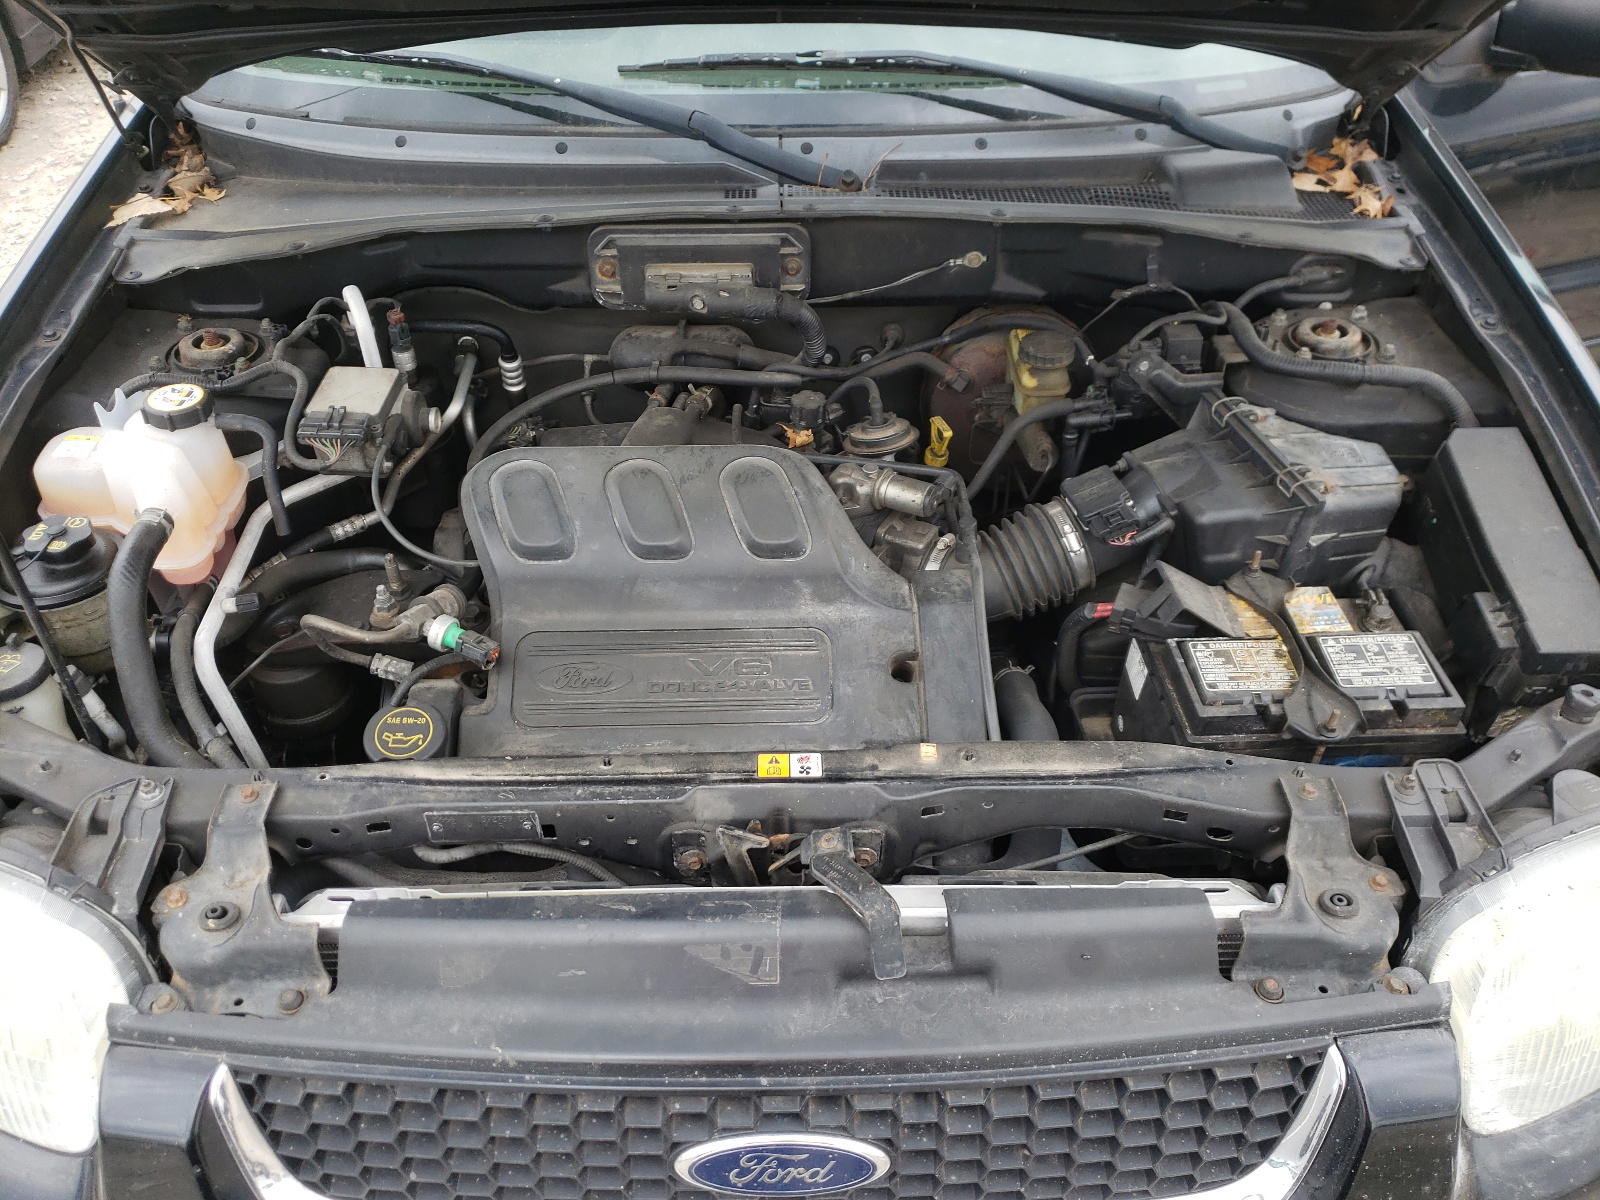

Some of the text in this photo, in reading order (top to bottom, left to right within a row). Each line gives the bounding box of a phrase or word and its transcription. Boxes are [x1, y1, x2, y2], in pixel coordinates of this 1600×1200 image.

[688, 657, 772, 676] V6
[553, 666, 613, 689] Ford
[648, 680, 711, 693] DOHC
[729, 1152, 837, 1184] Ford
